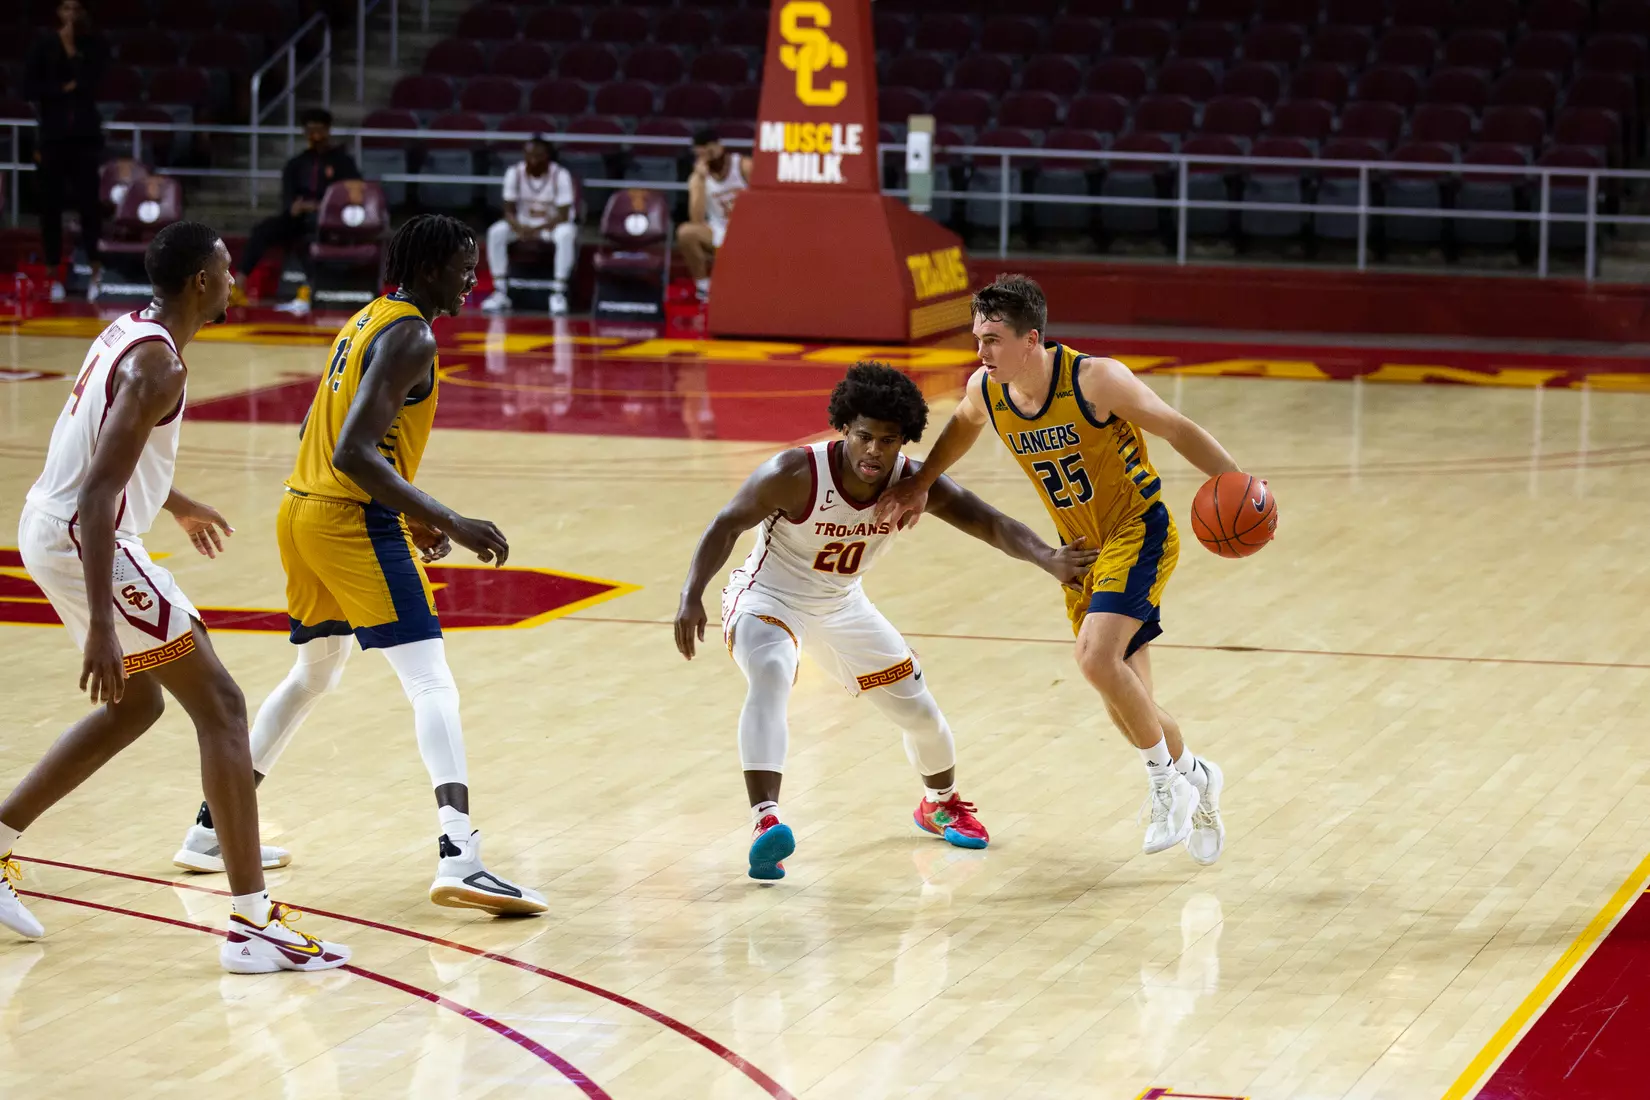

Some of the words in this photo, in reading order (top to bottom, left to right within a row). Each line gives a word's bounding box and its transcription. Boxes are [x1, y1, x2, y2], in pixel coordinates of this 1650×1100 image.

[779, 0, 848, 107] SC
[759, 121, 863, 155] MUSCLE
[777, 153, 843, 183] MILK
[71, 352, 100, 416] 4
[1055, 389, 1075, 399] WAC
[1006, 422, 1081, 455] LANCERS
[825, 489, 835, 503] C
[1032, 451, 1094, 509] 25
[814, 522, 890, 537] TROJANS
[812, 541, 867, 574] 20
[121, 584, 153, 611] SC
